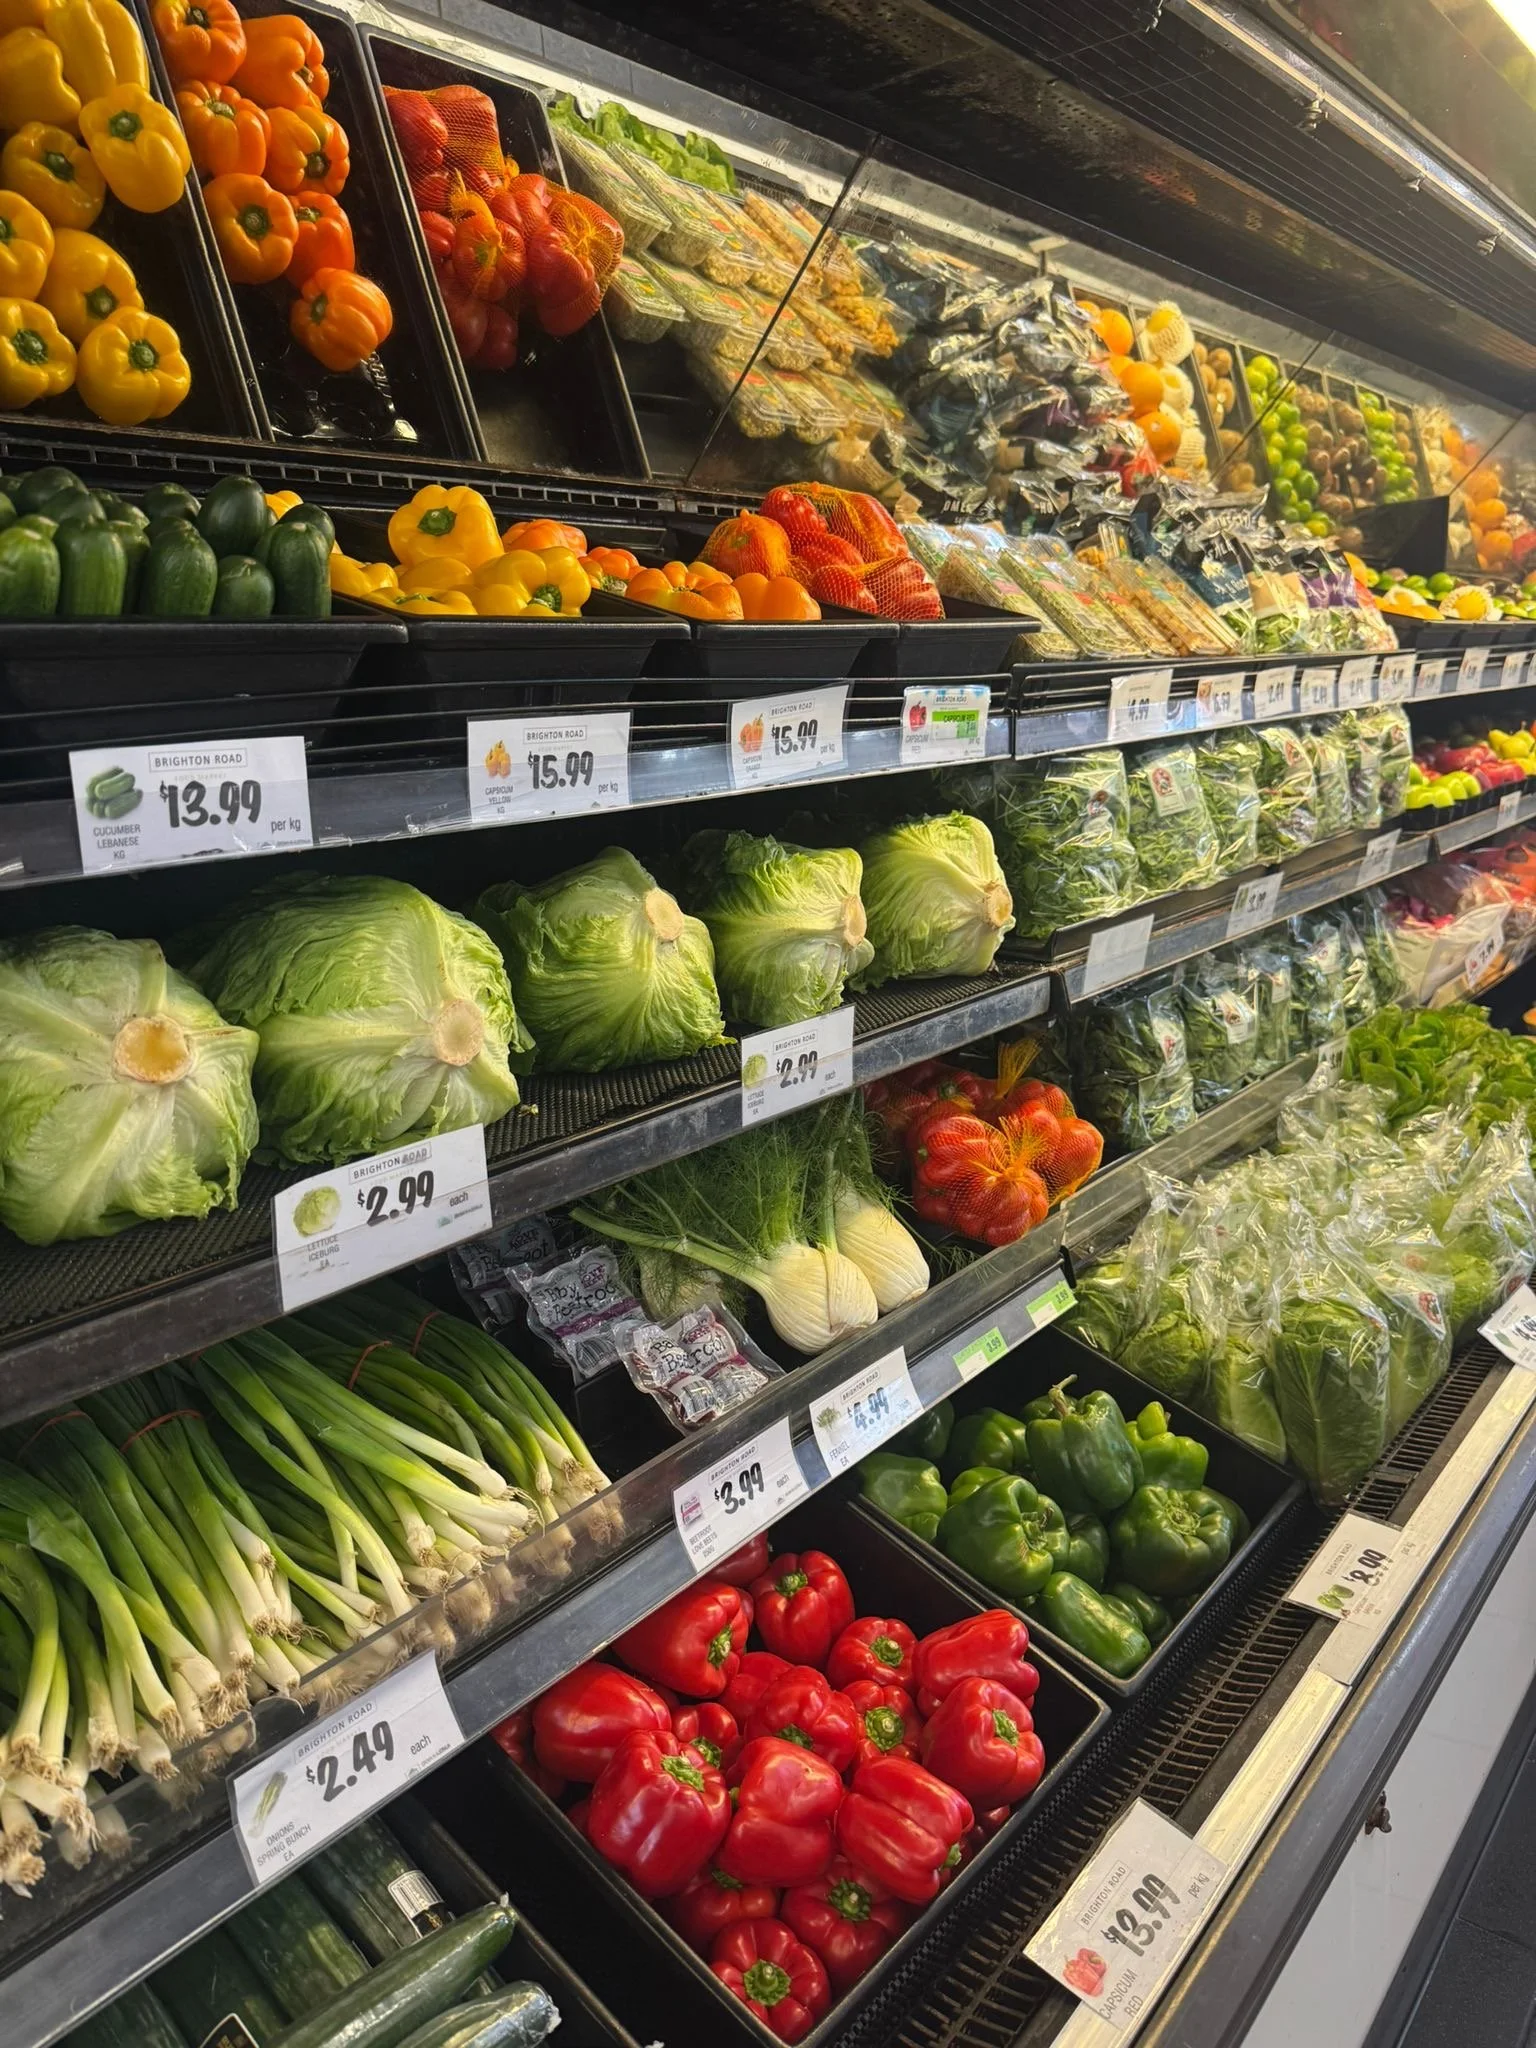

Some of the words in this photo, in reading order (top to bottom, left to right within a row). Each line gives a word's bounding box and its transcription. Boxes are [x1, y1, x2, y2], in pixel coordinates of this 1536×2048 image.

[771, 704, 797, 716] BRIGHTON
[798, 702, 812, 710] ROAD
[526, 730, 562, 741] BRIGHTON
[565, 729, 584, 738] ROAD
[772, 719, 818, 756] $15.99
[154, 756, 211, 768] BRIGHTON
[214, 754, 242, 765] ROAD
[528, 751, 594, 790] $15.99
[485, 785, 514, 795] CAPSICUM
[598, 784, 609, 794] per
[610, 781, 618, 794] kg
[160, 780, 262, 828] $13.99
[488, 796, 512, 804] YELLOW
[92, 824, 141, 837] CUCUMBER
[270, 822, 287, 834] per
[290, 817, 302, 832] kg
[97, 836, 140, 848] LEBANESE
[114, 850, 126, 860] KG
[776, 1038, 801, 1052] BRIGHTON
[802, 1033, 816, 1043] ROAD
[776, 1050, 818, 1088] $2.99
[354, 1156, 400, 1180] BRIGHTON
[402, 1148, 428, 1164] ROAD
[358, 1170, 434, 1226] $2.99
[450, 1192, 468, 1207] each
[307, 1234, 338, 1252] LETTUCE
[309, 1244, 340, 1262] ICEBURG
[842, 1381, 866, 1400] BRIGHTON
[866, 1371, 878, 1382] ROAD
[830, 1440, 850, 1460] FENNEL
[711, 1458, 740, 1480] BRIGHTON
[741, 1446, 756, 1460] ROAD
[840, 1456, 850, 1467] EA
[714, 1462, 764, 1514] $3.99
[776, 1473, 790, 1488] each
[1342, 1548, 1394, 1587] $8.99
[298, 1721, 346, 1758] BRIGHTON
[348, 1702, 373, 1723] ROAD
[410, 1735, 432, 1756] each
[306, 1720, 394, 1802] $2.49
[266, 1821, 295, 1846] ONIONS
[257, 1843, 286, 1867] SPRING
[286, 1824, 312, 1850] BUNCH
[284, 1850, 294, 1863] EA
[1081, 1885, 1111, 1926] BRIGHTON
[1108, 1866, 1127, 1889] ROAD
[1188, 1879, 1200, 1899] per
[1196, 1871, 1210, 1887] kg
[1102, 1873, 1180, 1958] $13.99
[1099, 1968, 1138, 2020] CAPSICUM
[1124, 1995, 1144, 2018] RED
